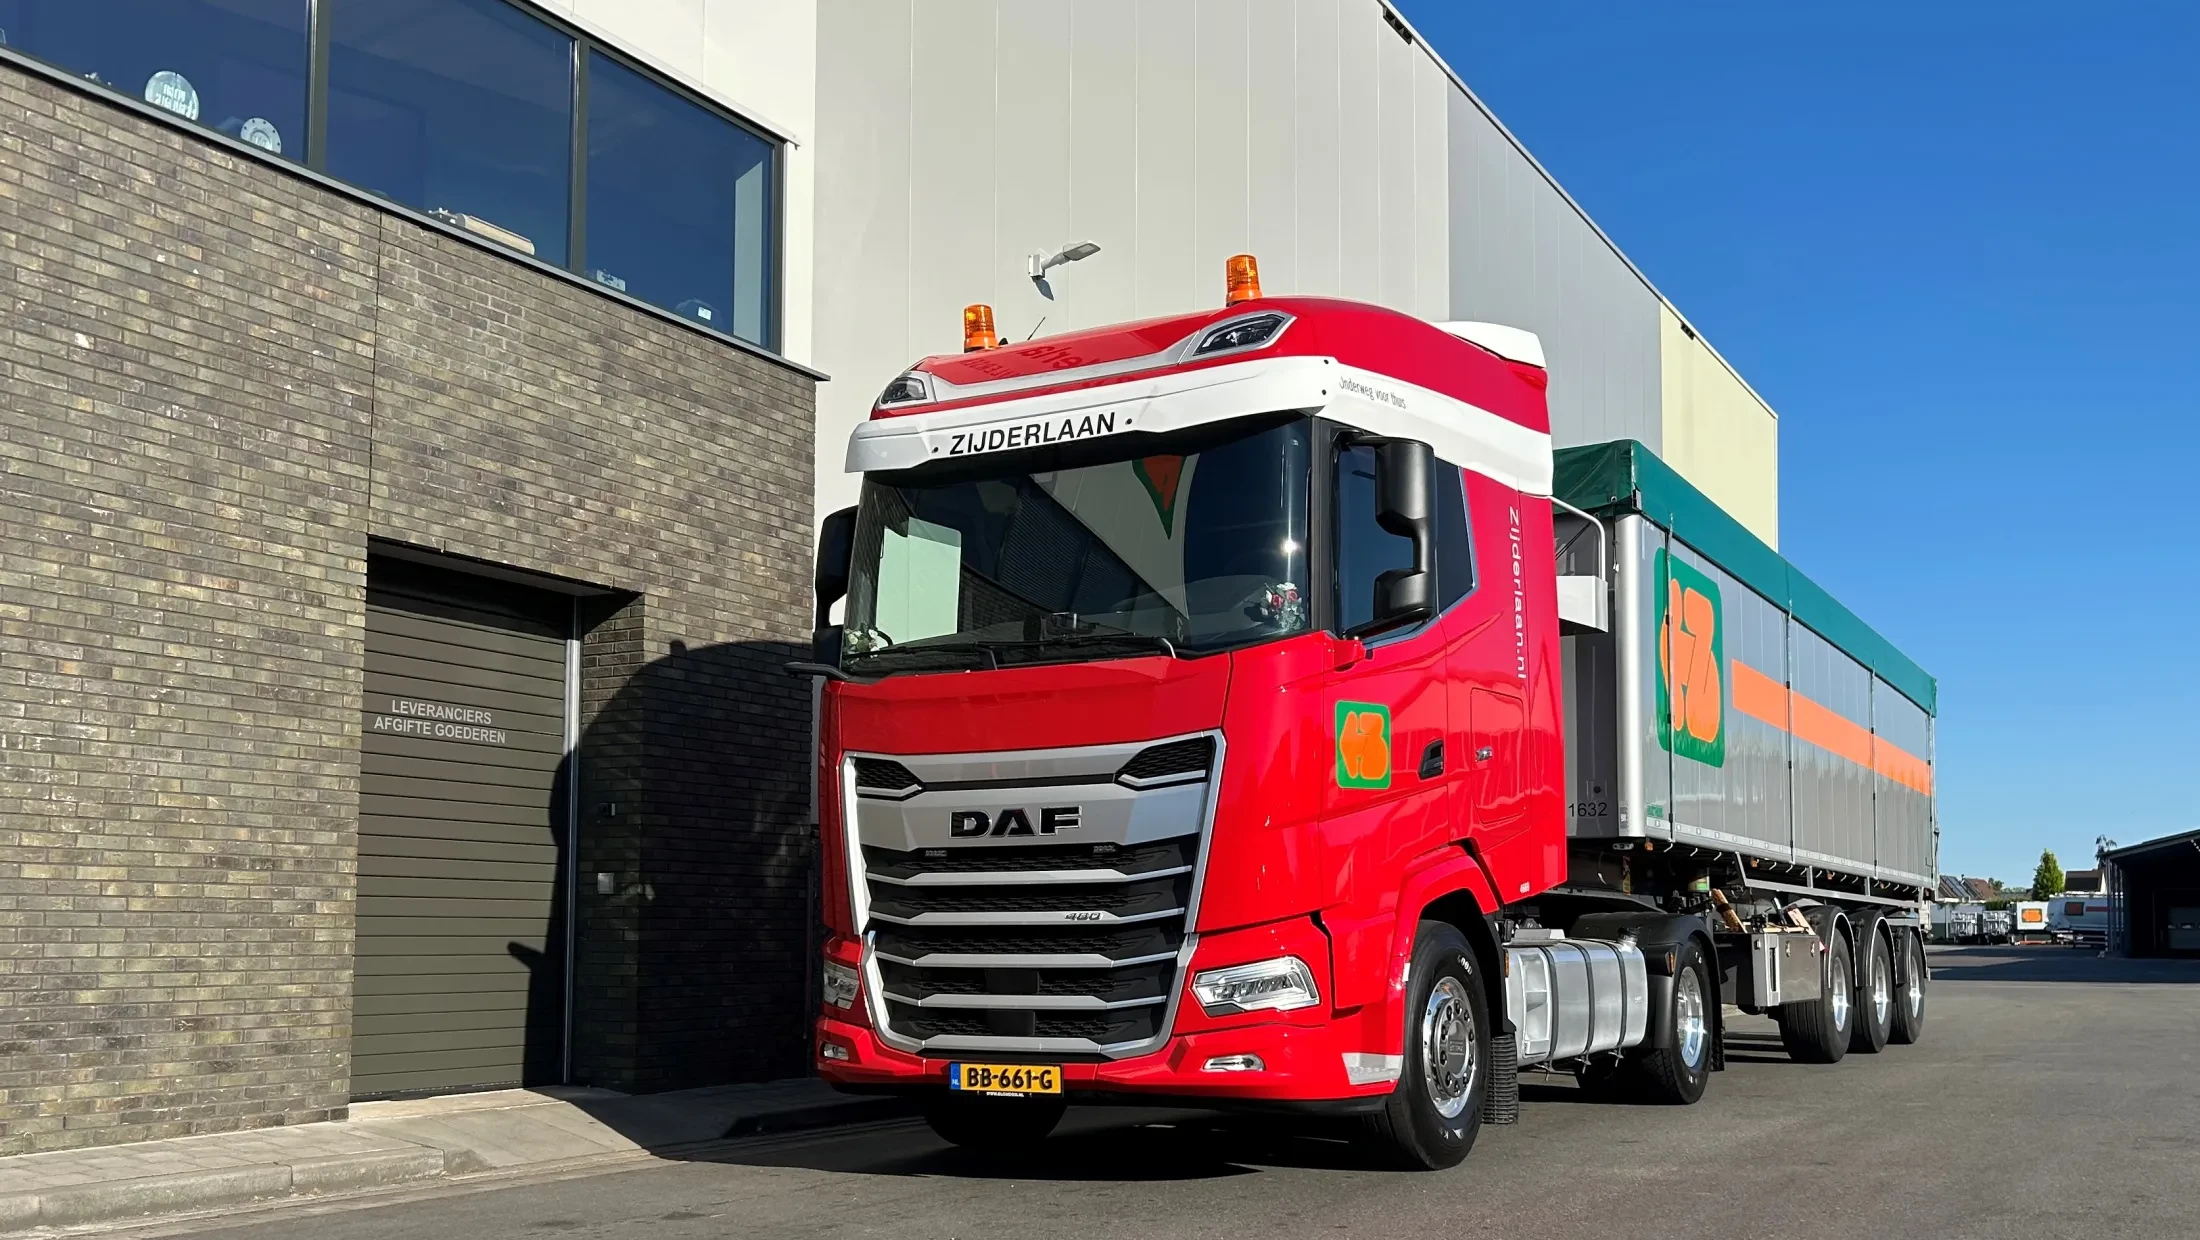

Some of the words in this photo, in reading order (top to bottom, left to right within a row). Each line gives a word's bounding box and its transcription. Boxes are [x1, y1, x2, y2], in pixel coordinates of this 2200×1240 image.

[949, 412, 1116, 455] ZIJDERLAAN
[1509, 505, 1527, 679] Zijderlaan.nl
[392, 700, 492, 724] LEVERANCIERS
[374, 716, 432, 735] AFGIFTE
[435, 723, 506, 743] GOEDEREN
[949, 805, 1083, 839] DAF
[1568, 802, 1608, 818] 1632
[967, 1067, 1053, 1090] BB-661-G
